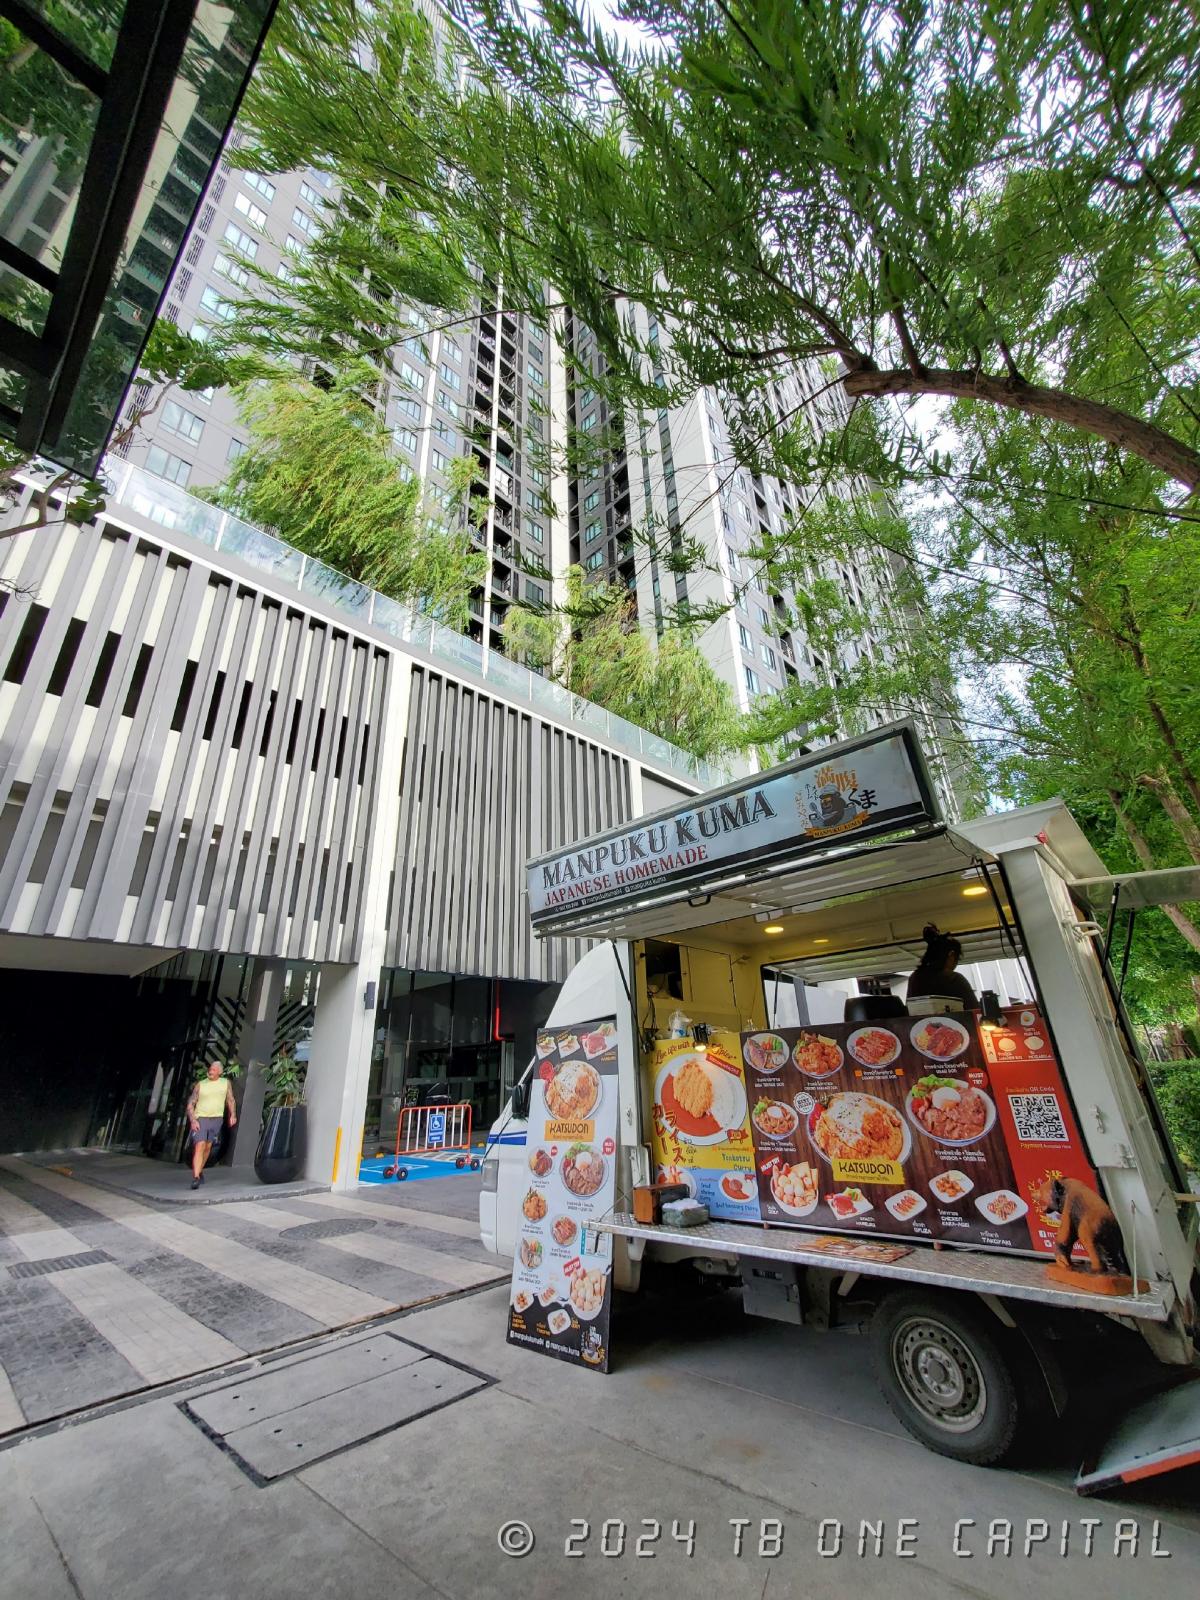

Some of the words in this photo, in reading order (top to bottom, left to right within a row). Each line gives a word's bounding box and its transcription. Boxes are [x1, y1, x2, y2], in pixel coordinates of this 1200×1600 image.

[847, 788, 878, 810] くま
[542, 825, 668, 890] MANPUKU
[674, 790, 778, 847] KUMA
[545, 874, 612, 907] JAPANESE
[614, 844, 709, 886] HOMEMADE
[550, 1123, 589, 1134] KATSUDON
[652, 1103, 668, 1155] カレー
[665, 1111, 686, 1165] ライス
[838, 1162, 895, 1176] KATSUDON
[981, 1237, 1012, 1246] TAKOYAKI
